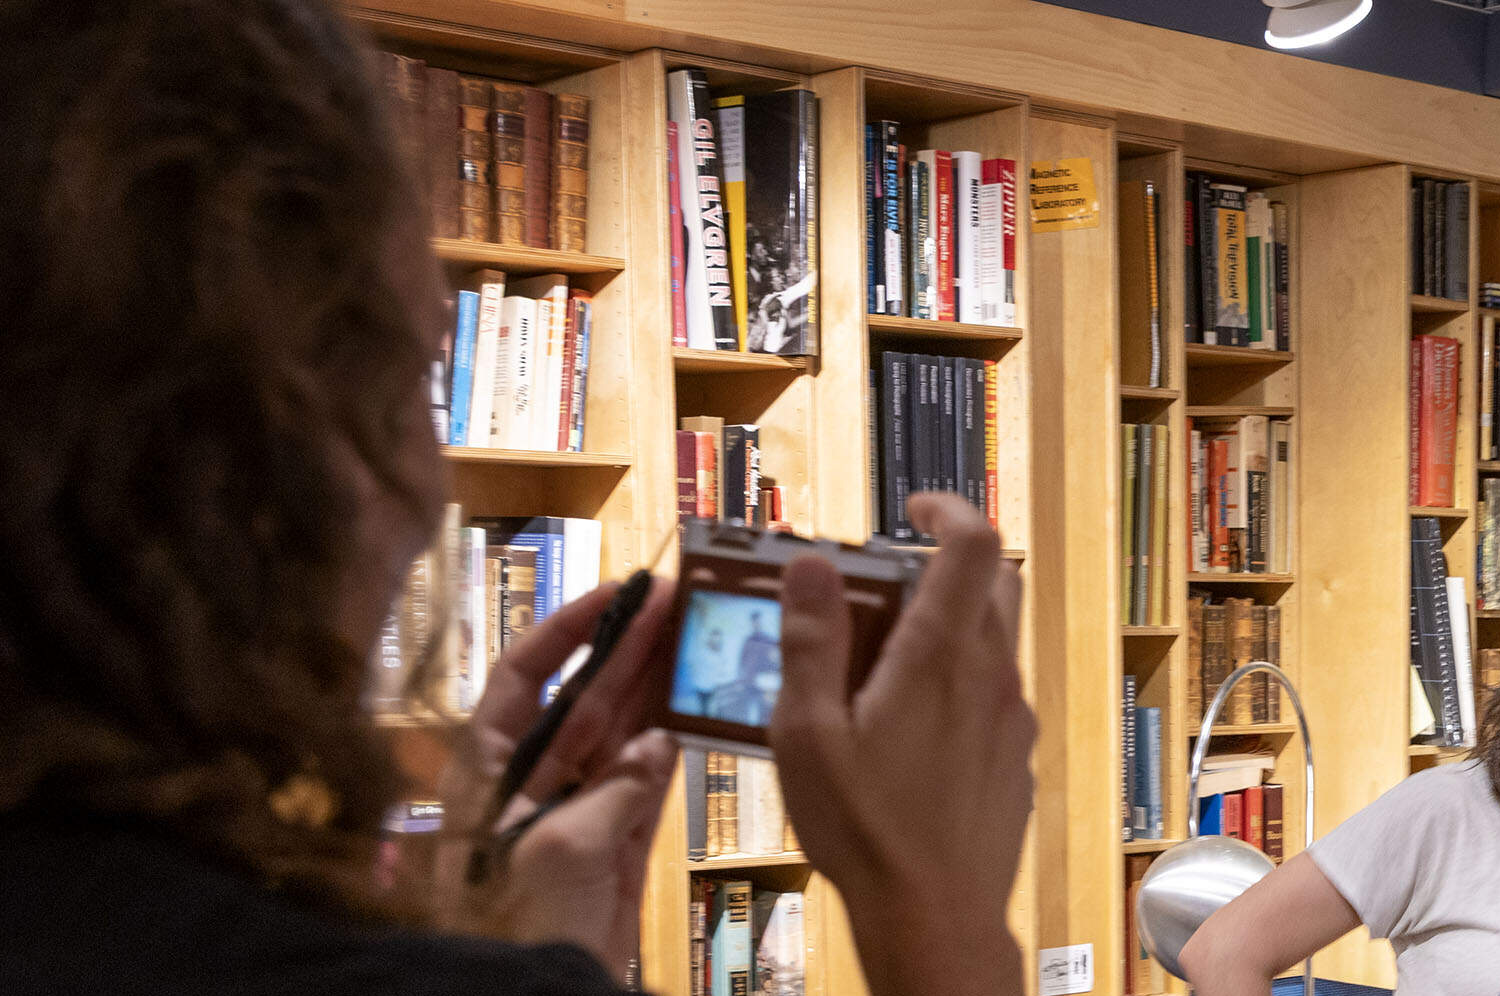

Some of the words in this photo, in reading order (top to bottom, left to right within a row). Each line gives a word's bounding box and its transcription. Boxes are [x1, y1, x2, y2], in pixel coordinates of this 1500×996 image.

[693, 119, 717, 166] GIL
[887, 173, 898, 197] FOR
[970, 178, 980, 228] MONSTERS
[1002, 168, 1016, 237] ZIPPER
[1030, 183, 1080, 195] REFERENCE
[1031, 198, 1086, 210] LABORATORY
[887, 199, 899, 231] ELVIS
[1226, 213, 1238, 241] TOTAL
[697, 175, 733, 307] ELVGREN
[1228, 243, 1240, 300] TELEVISION
[984, 364, 998, 414] WILD
[984, 419, 998, 471] THING
[1127, 681, 1136, 712] RAFAEL
[1127, 715, 1136, 758] YGLESIAS
